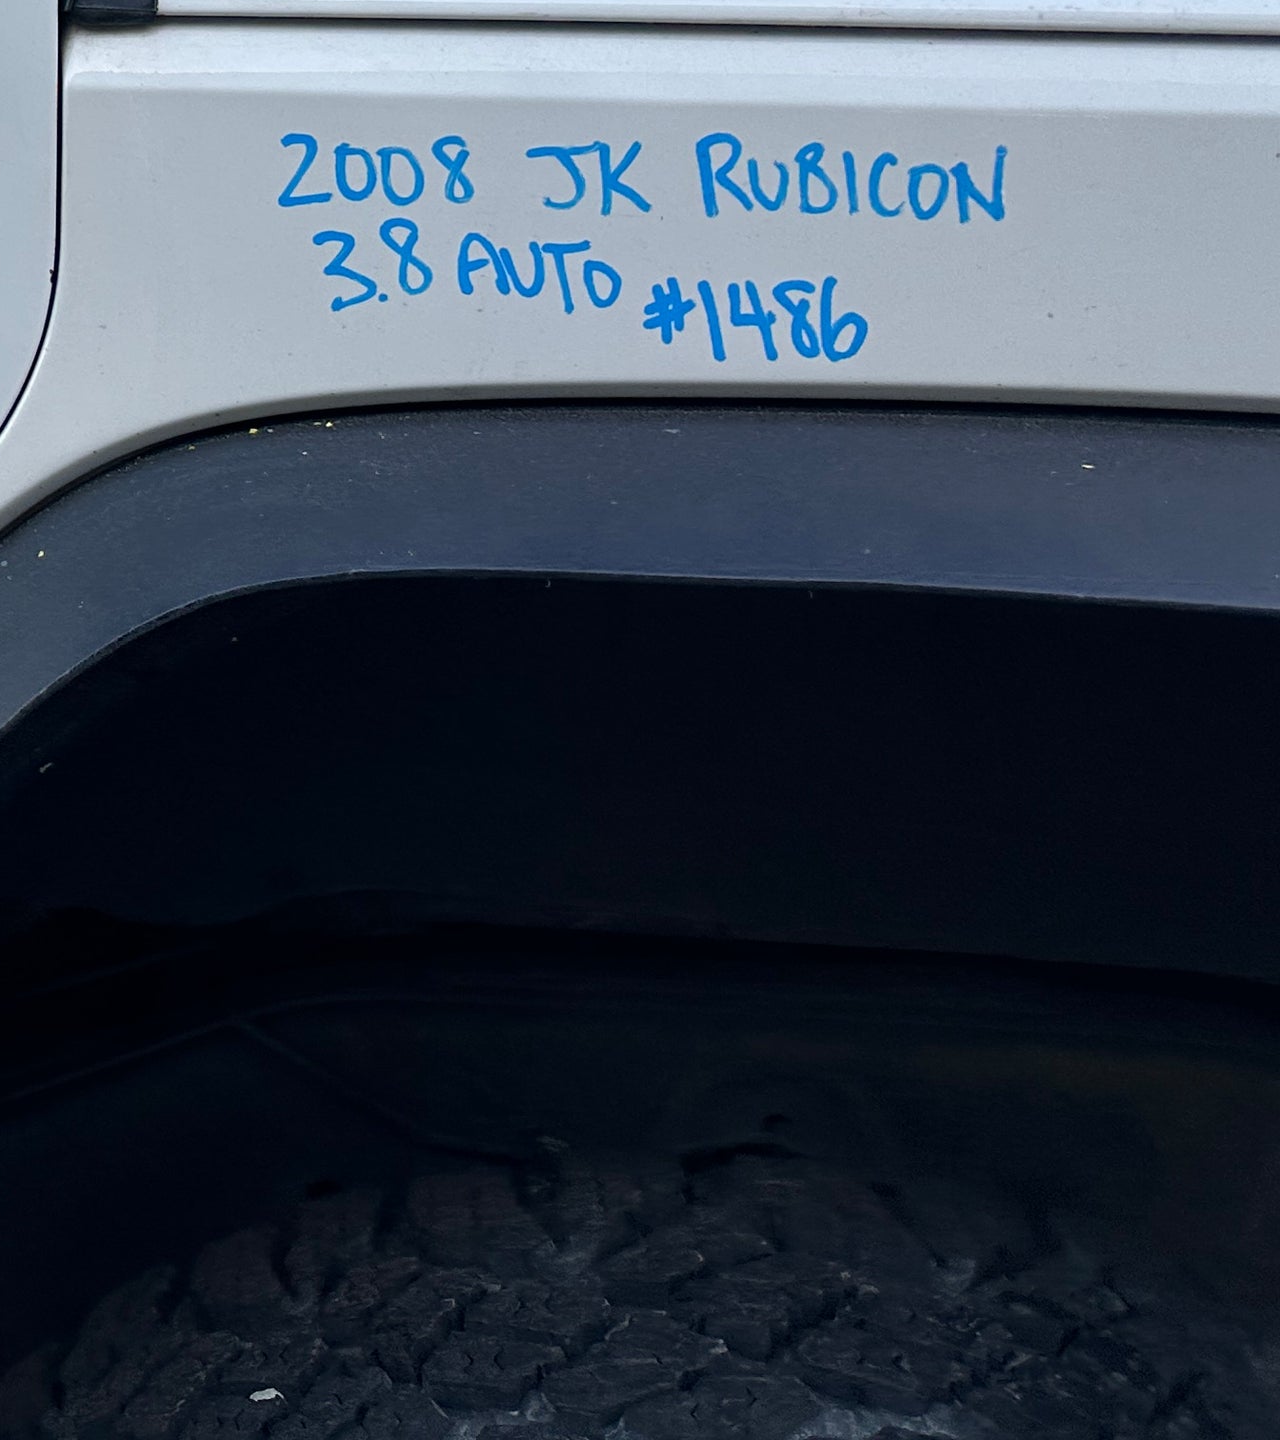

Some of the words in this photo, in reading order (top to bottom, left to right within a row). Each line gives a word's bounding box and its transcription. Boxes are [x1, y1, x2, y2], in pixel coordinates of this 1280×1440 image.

[277, 132, 475, 208] 2008
[525, 140, 652, 216] JK
[695, 132, 1008, 224] RUBICON
[312, 217, 434, 312] 3.8
[456, 232, 623, 315] AUTO
[642, 275, 869, 363] #1486
